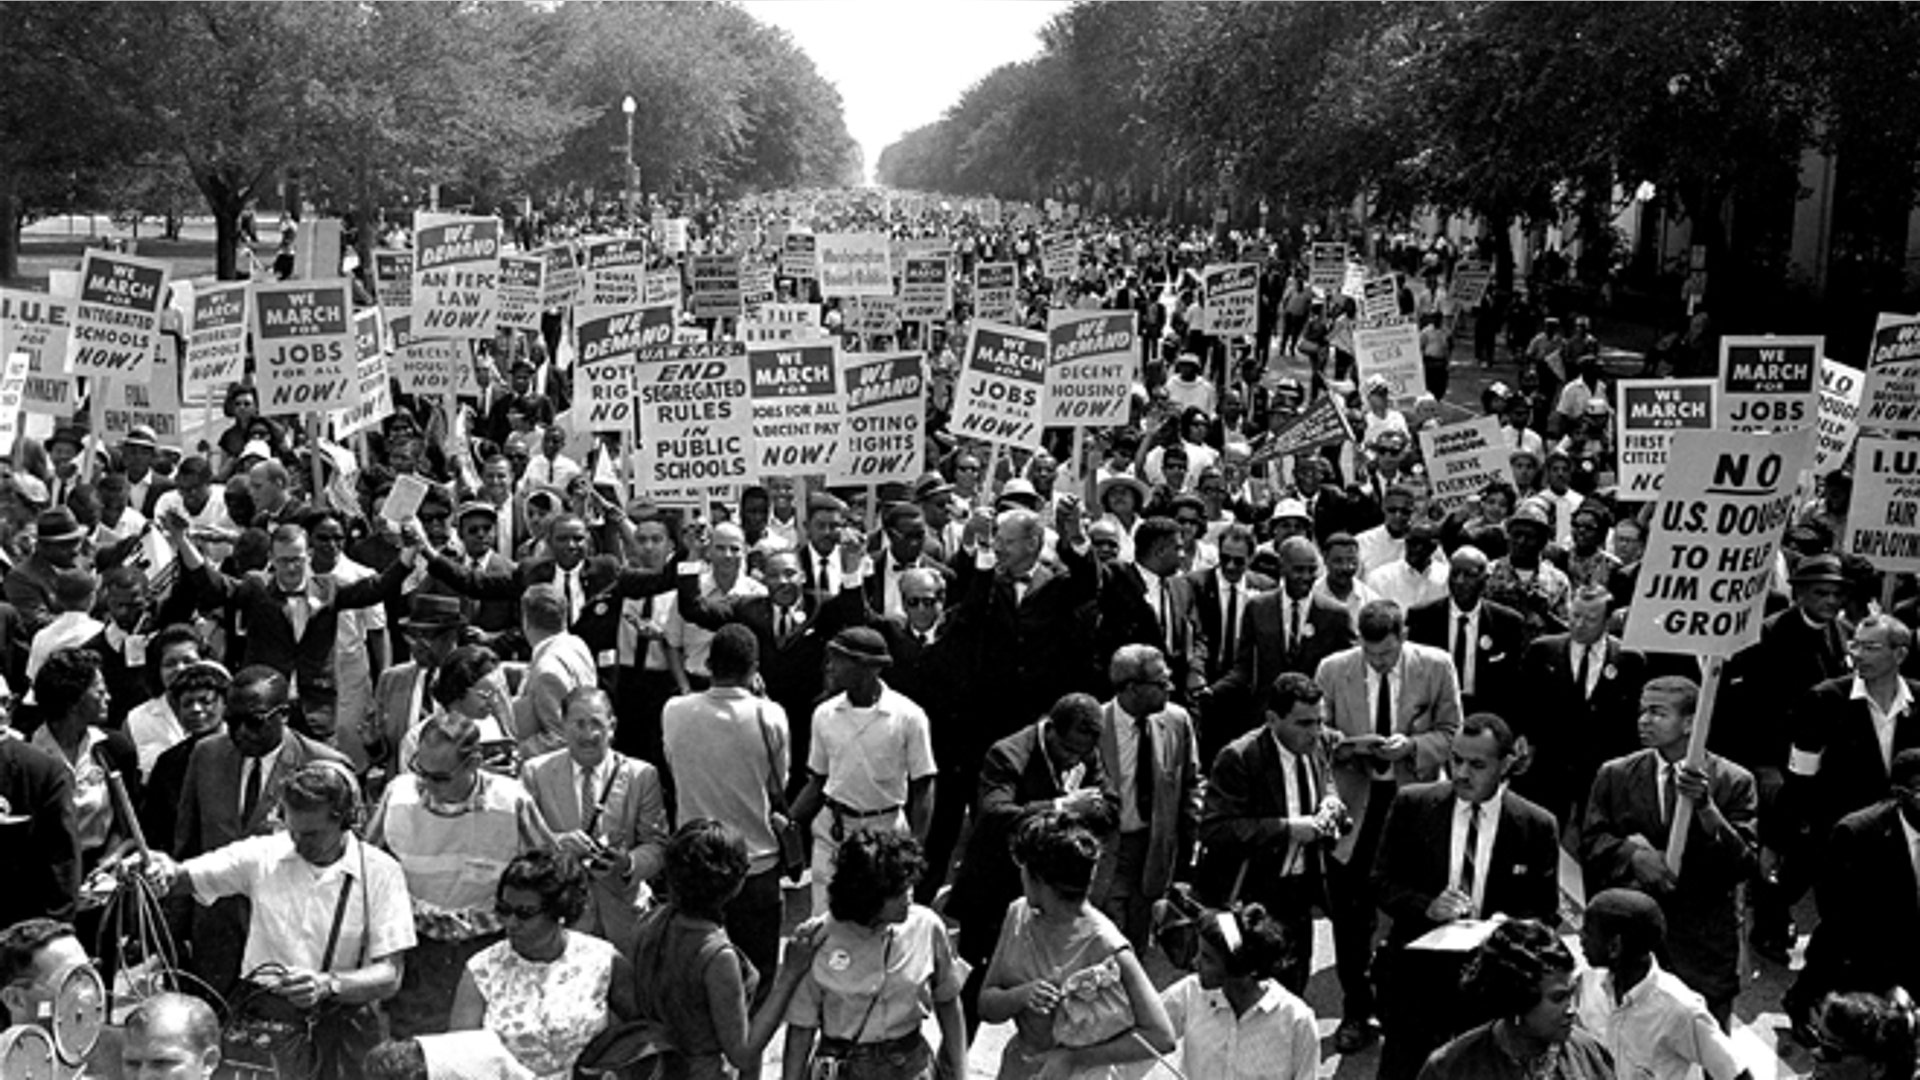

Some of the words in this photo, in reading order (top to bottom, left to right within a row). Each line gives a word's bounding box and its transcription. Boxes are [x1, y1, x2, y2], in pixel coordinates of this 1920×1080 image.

[444, 224, 475, 243] WE
[422, 239, 496, 266] DEMAND
[113, 264, 135, 281] WE
[422, 273, 448, 287] AN
[88, 274, 155, 300] MARCH
[287, 291, 315, 306] WE
[438, 291, 480, 306] LAW
[2, 297, 70, 328] I.U.E.
[266, 305, 341, 325] MARCH
[423, 309, 490, 329] NOW!
[289, 325, 320, 335] FOR
[608, 313, 644, 335] WE
[1076, 320, 1109, 339] WE
[75, 325, 150, 349] SCHOOLS
[584, 324, 671, 360] DEMAND
[1003, 338, 1027, 353] WE
[1054, 332, 1130, 361] DEMAND
[75, 346, 144, 372] NOW!
[269, 341, 343, 366] JOBS
[776, 352, 803, 366] WE
[977, 346, 1045, 373] MARCH
[1759, 350, 1785, 363] WE
[272, 367, 305, 379] FOR
[314, 364, 342, 375] ALL
[657, 361, 727, 382] END
[756, 365, 830, 385] MARCH
[861, 362, 893, 385] WE
[994, 366, 1022, 378] FOR
[1060, 365, 1124, 380] DECENT
[1733, 363, 1808, 381] MARCH
[272, 379, 349, 405] NOW!
[592, 385, 629, 400] RIG
[642, 380, 746, 404] SEGREGATED
[778, 384, 807, 394] FOR
[851, 375, 920, 406] EMAND
[970, 379, 1037, 407] JOBS
[1052, 384, 1127, 398] HOUSING
[1655, 389, 1681, 401] WE
[1755, 381, 1785, 392] FOR
[590, 404, 629, 421] NO
[657, 402, 731, 423] RULES
[786, 404, 812, 417] FOR
[815, 401, 840, 415] ALL
[968, 399, 997, 411] FOR
[1055, 399, 1123, 419] NOW!
[1631, 402, 1705, 418] MARCH
[1730, 402, 1804, 422] JOBS
[682, 426, 708, 438] IN
[813, 422, 841, 435] PAY
[847, 414, 918, 432] OTING
[962, 413, 1034, 441] NOW!
[1653, 418, 1682, 427] FOR
[656, 437, 740, 458] PUBLIC
[1625, 435, 1664, 449] FIRST
[762, 441, 838, 466] NOW!
[1622, 452, 1667, 464] CITIZE
[654, 457, 746, 480] SCHOOLS
[1713, 454, 1782, 488] NO
[1661, 501, 1709, 534] U.S.
[1885, 501, 1918, 527] FAIR
[1672, 545, 1709, 570] TO
[1717, 541, 1772, 572] HELP
[1644, 574, 1699, 601] JIM
[1663, 609, 1752, 637] GROW
